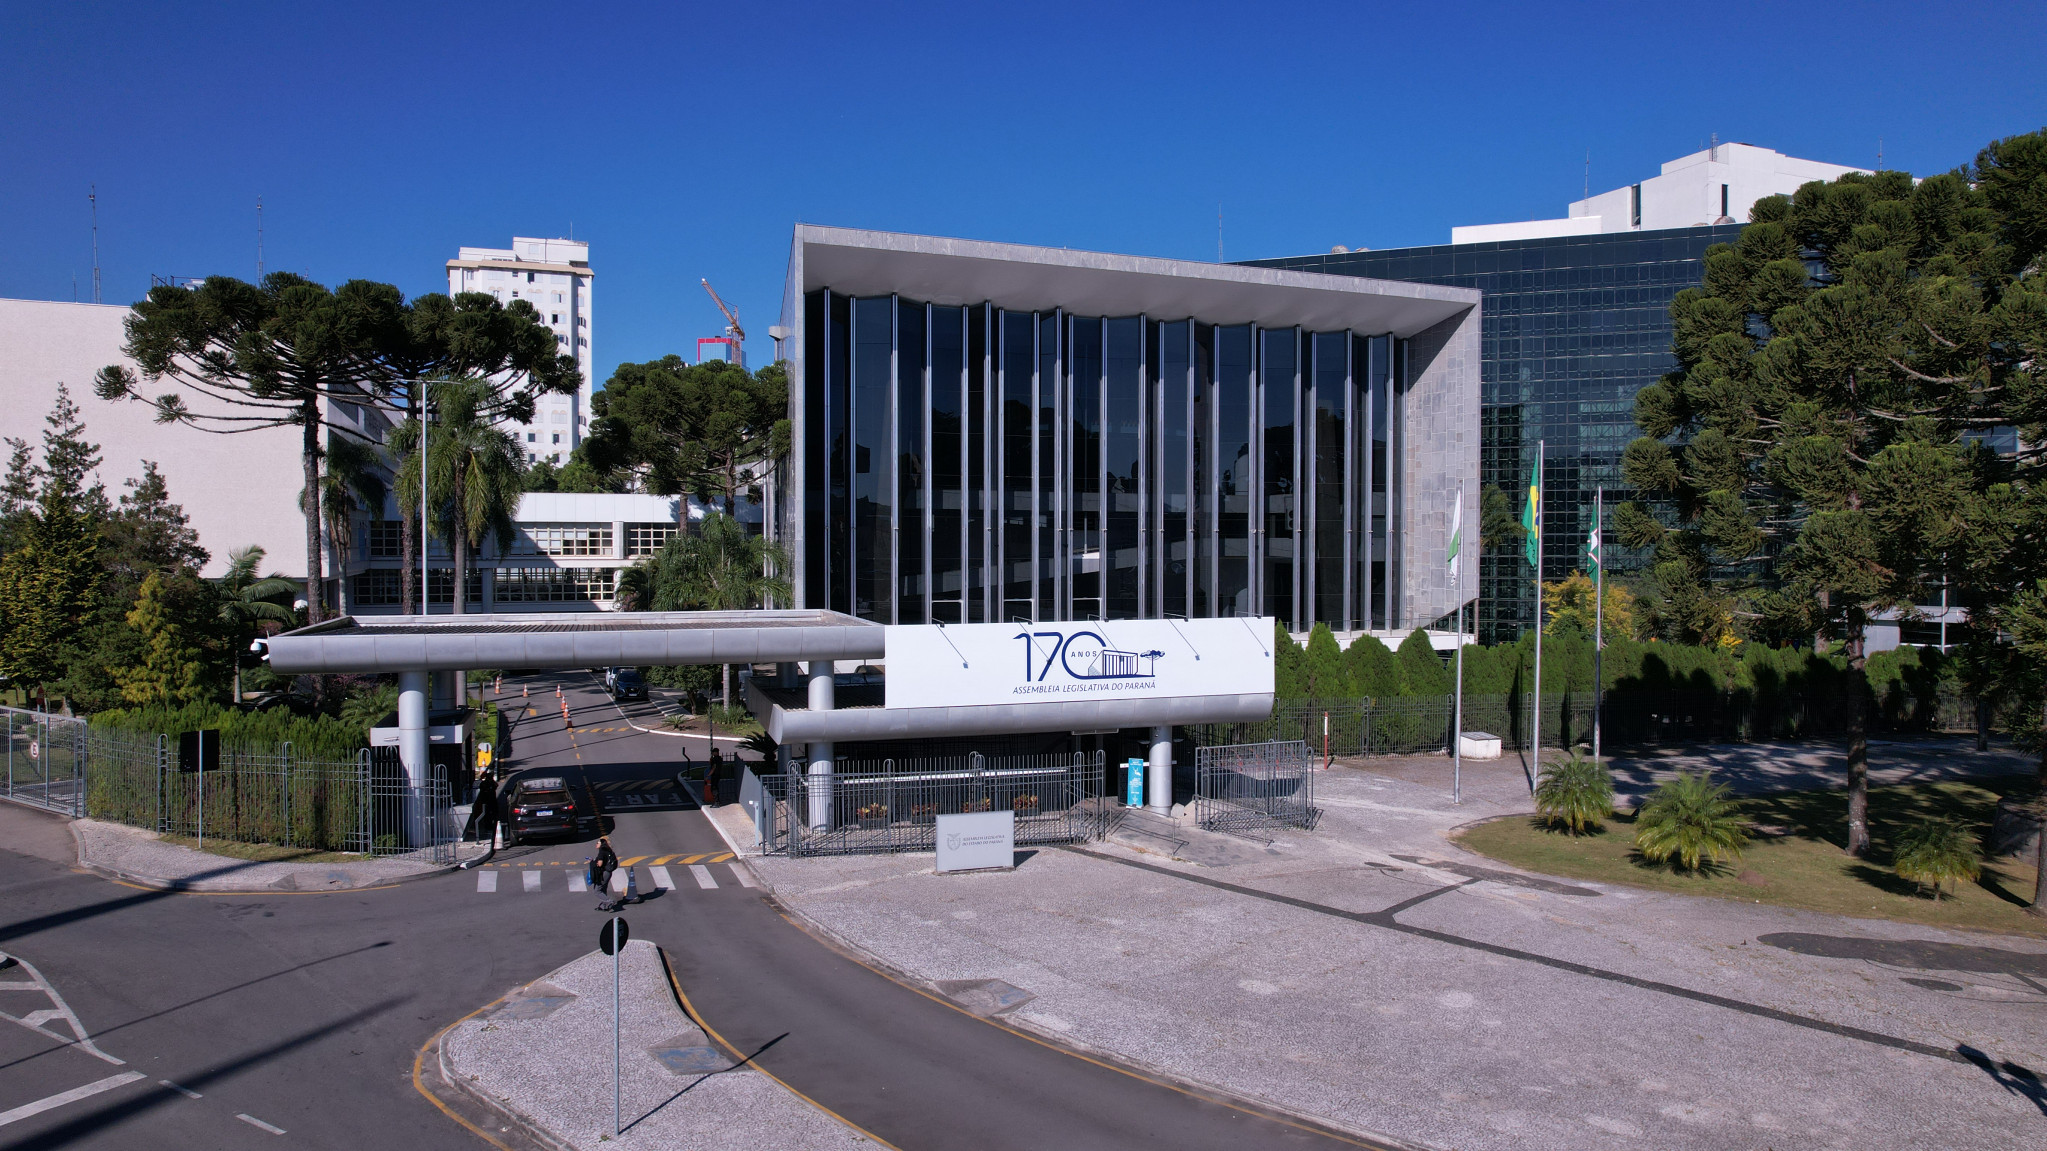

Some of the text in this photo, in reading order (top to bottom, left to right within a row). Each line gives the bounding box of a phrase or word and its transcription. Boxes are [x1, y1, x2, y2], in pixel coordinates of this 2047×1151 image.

[1012, 631, 1107, 682] 170
[1013, 680, 1156, 694] ASSEMBLEIA LEGISLATIVA DO PARANÁ
